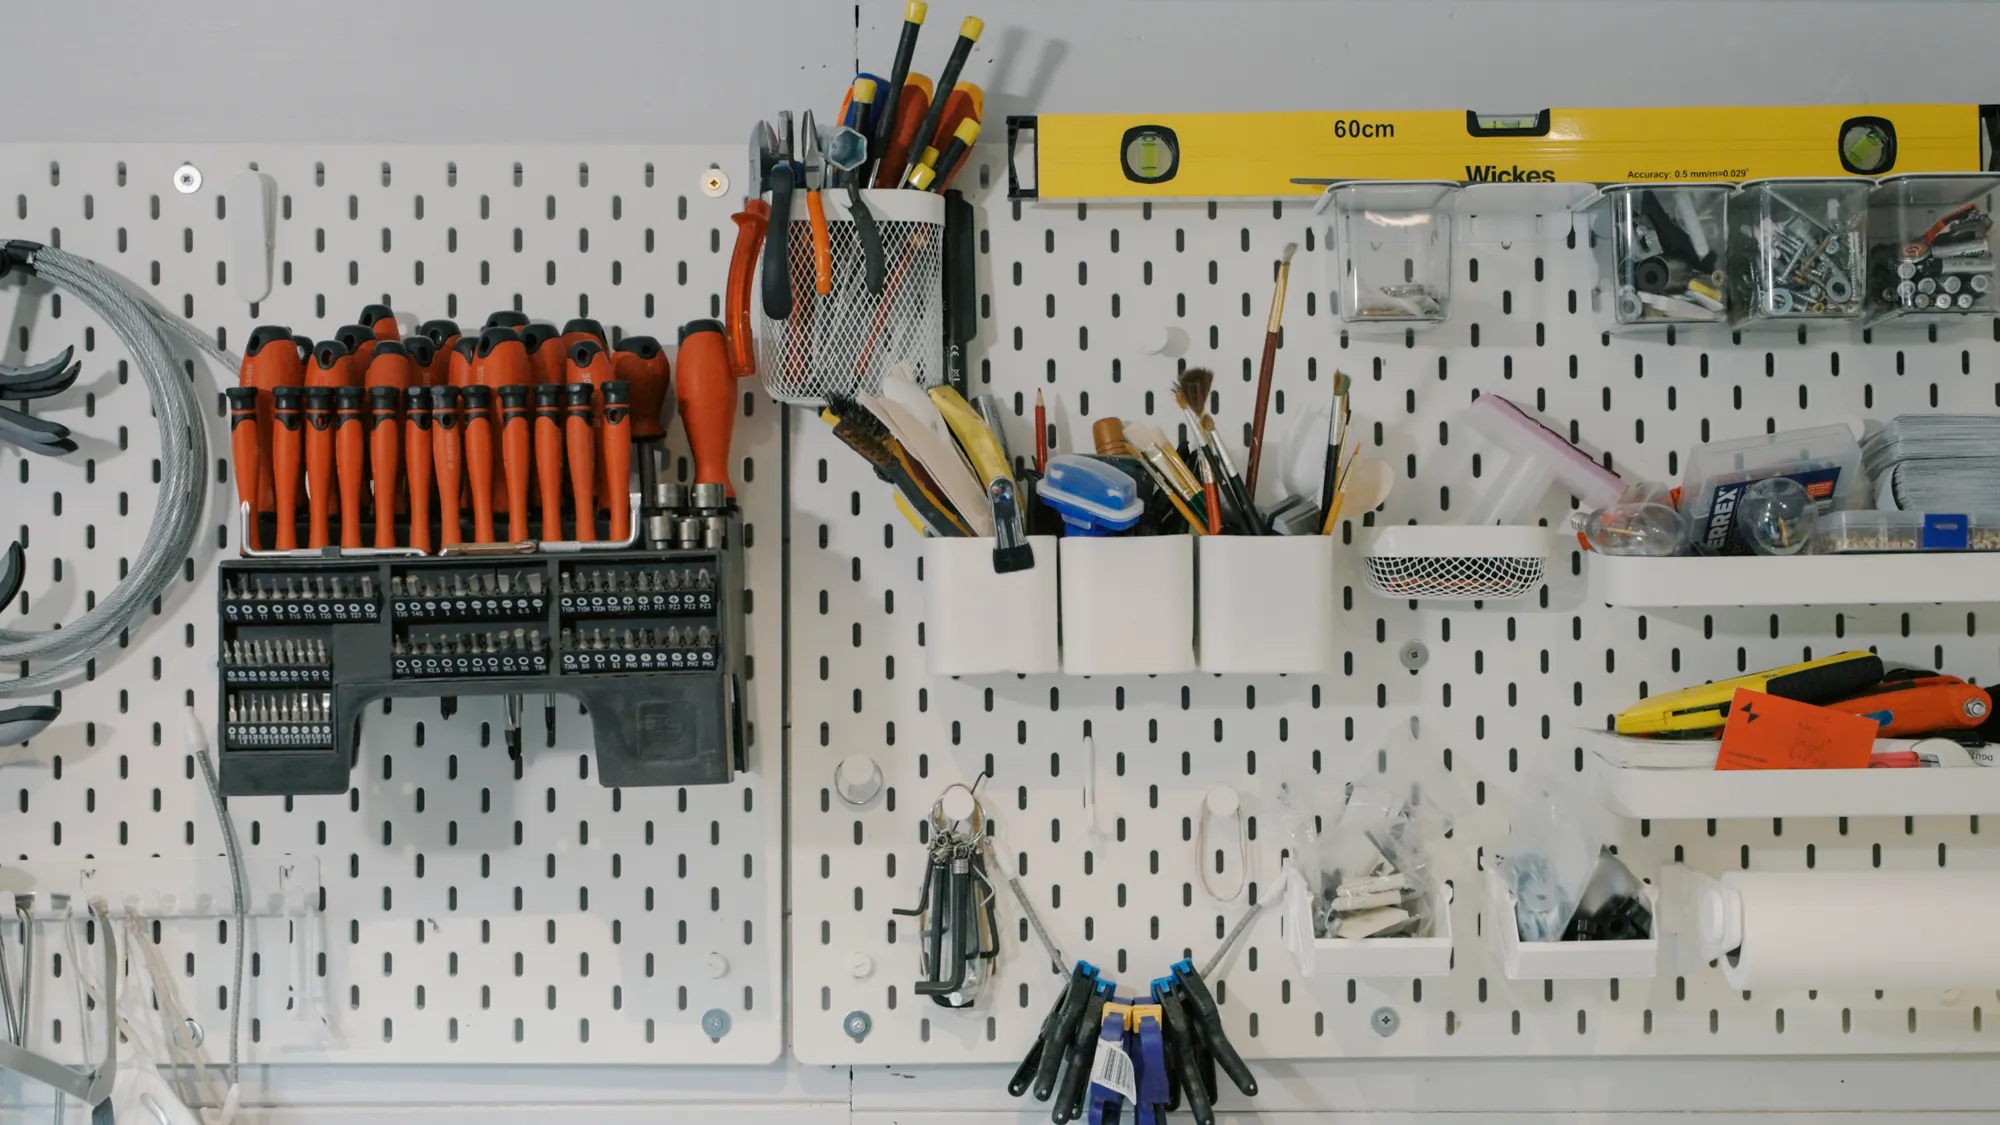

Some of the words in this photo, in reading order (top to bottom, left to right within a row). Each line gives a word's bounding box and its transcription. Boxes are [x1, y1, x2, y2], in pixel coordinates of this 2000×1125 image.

[1334, 120, 1394, 138] 60cm
[1465, 165, 1556, 182] Wickes
[1628, 170, 1671, 180] Accuracy:
